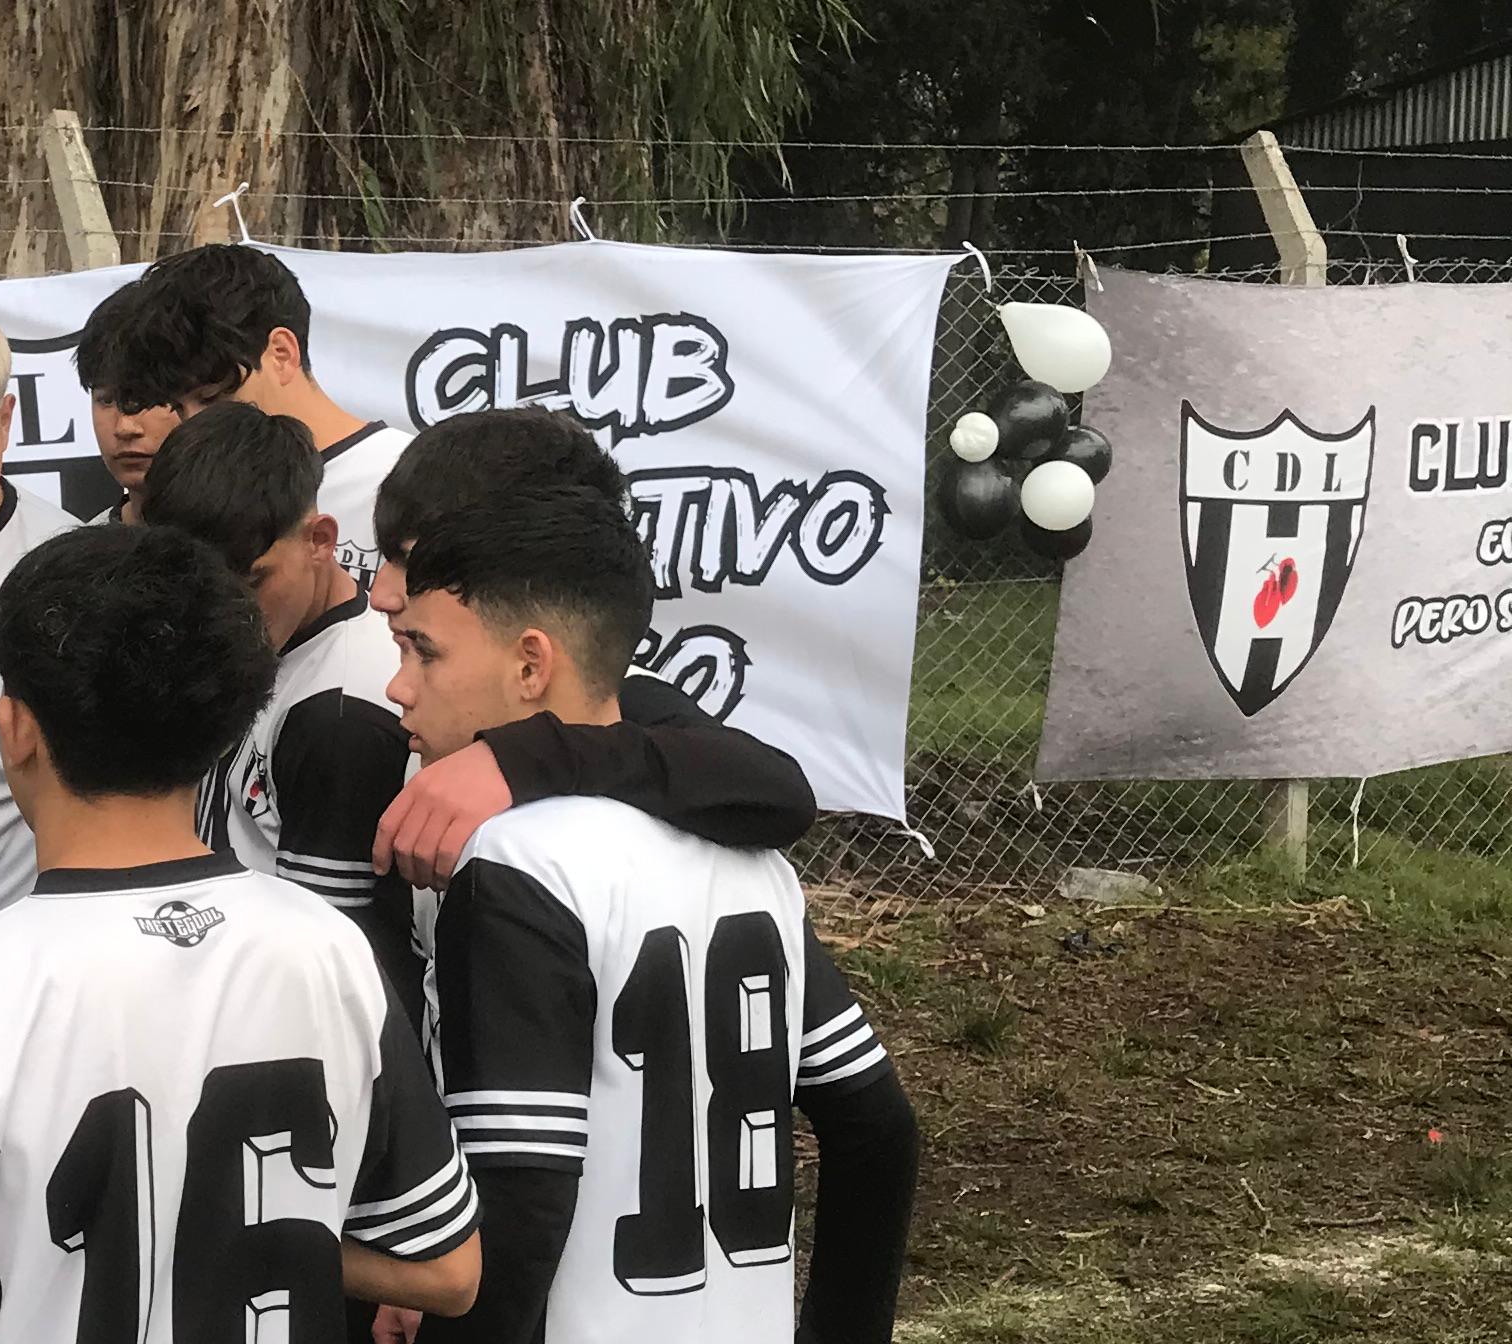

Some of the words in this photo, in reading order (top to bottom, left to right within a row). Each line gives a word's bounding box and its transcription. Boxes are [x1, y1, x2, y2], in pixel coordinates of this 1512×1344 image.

[406, 312, 736, 447] CLUB
[624, 465, 892, 600] TIVO
[1391, 593, 1492, 649] PERO
[135, 906, 225, 938] METEGOOL
[611, 910, 795, 1297] 18
